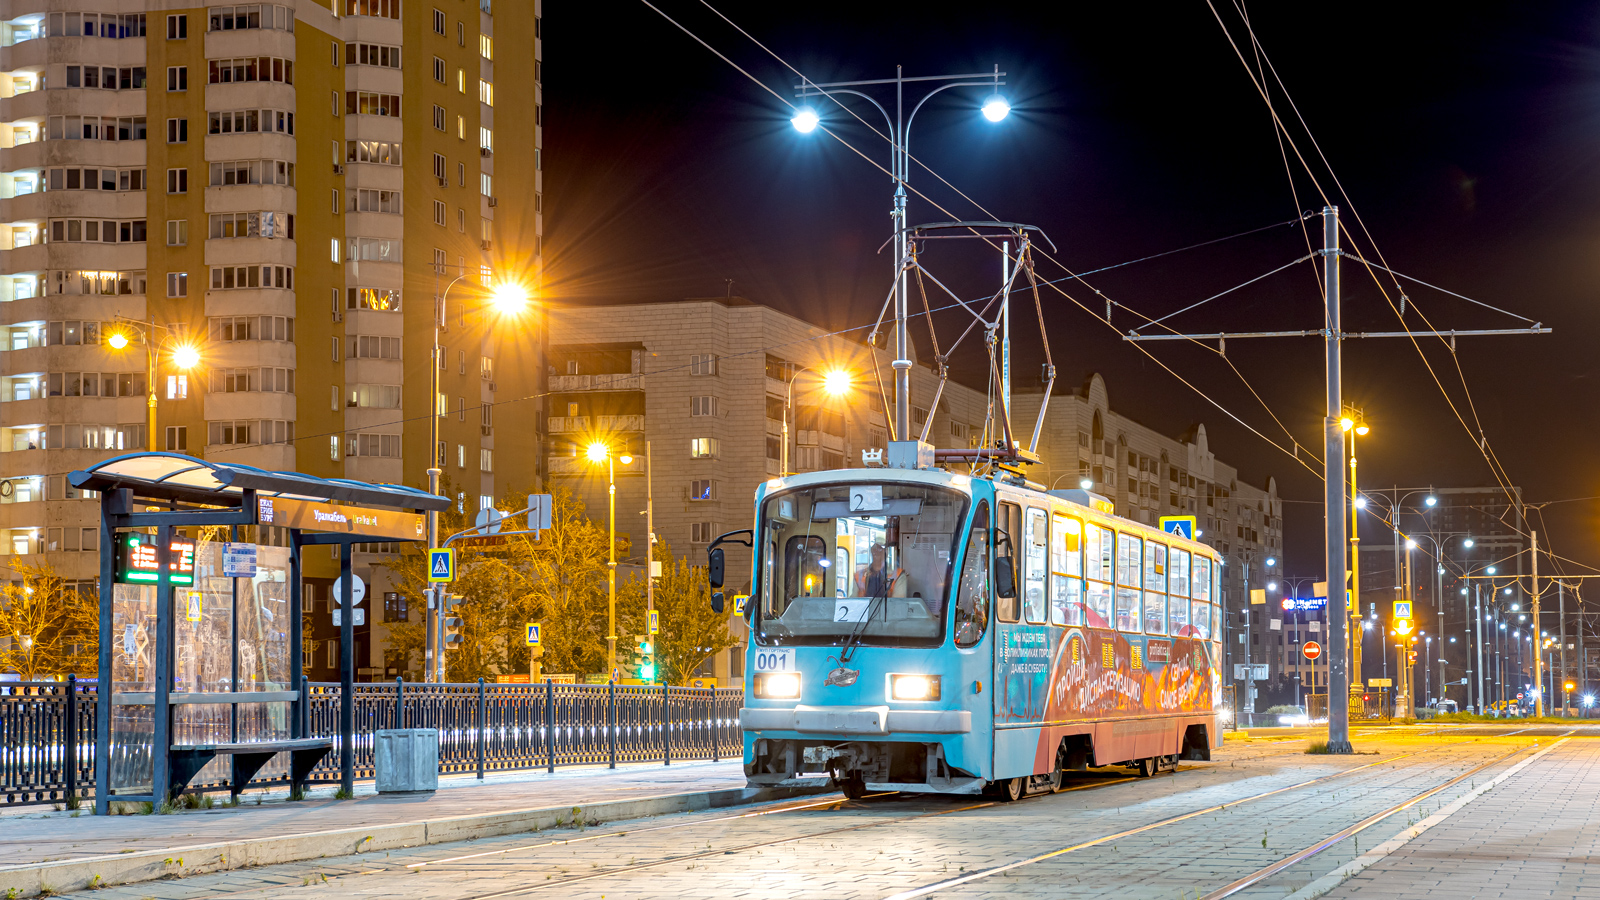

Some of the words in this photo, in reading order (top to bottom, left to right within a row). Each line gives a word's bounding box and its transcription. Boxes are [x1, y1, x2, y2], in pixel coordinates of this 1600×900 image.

[853, 493, 865, 512] 2
[314, 509, 347, 523] Уралкабель
[352, 514, 378, 526] Uralkabel
[837, 605, 849, 622] 2
[1013, 633, 1021, 642] МЫ
[1022, 633, 1035, 644] ЖДЕМ
[1036, 633, 1046, 643] ТЕБЯ
[757, 653, 787, 671] 001
[1010, 663, 1025, 675] ДАЖЕ
[1056, 658, 1086, 707] ПРОЙДИ
[1079, 670, 1141, 714] ДИСПАНСЕРИЗАЦИЮ
